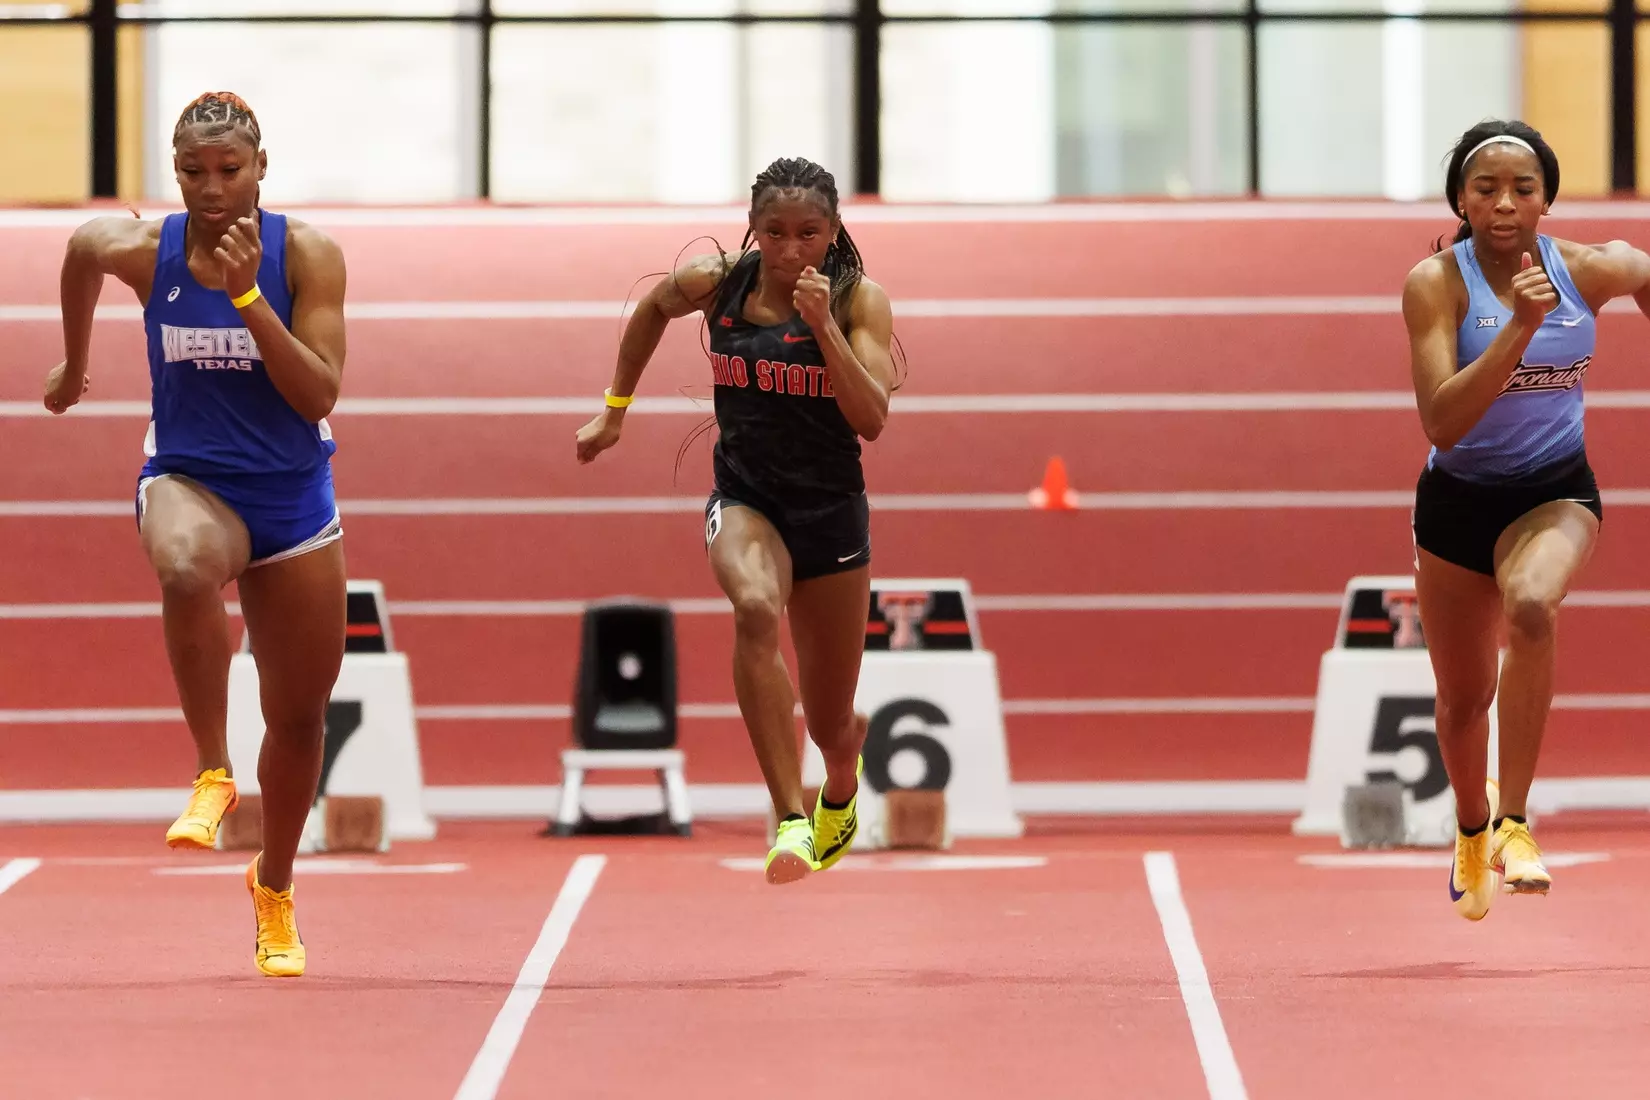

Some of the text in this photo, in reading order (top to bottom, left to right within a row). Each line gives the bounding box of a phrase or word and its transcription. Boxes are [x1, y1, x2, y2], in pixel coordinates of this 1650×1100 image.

[193, 360, 252, 371] TEXAS
[756, 360, 835, 397] STATE
[863, 698, 953, 795] 6
[1365, 696, 1451, 801] 5
